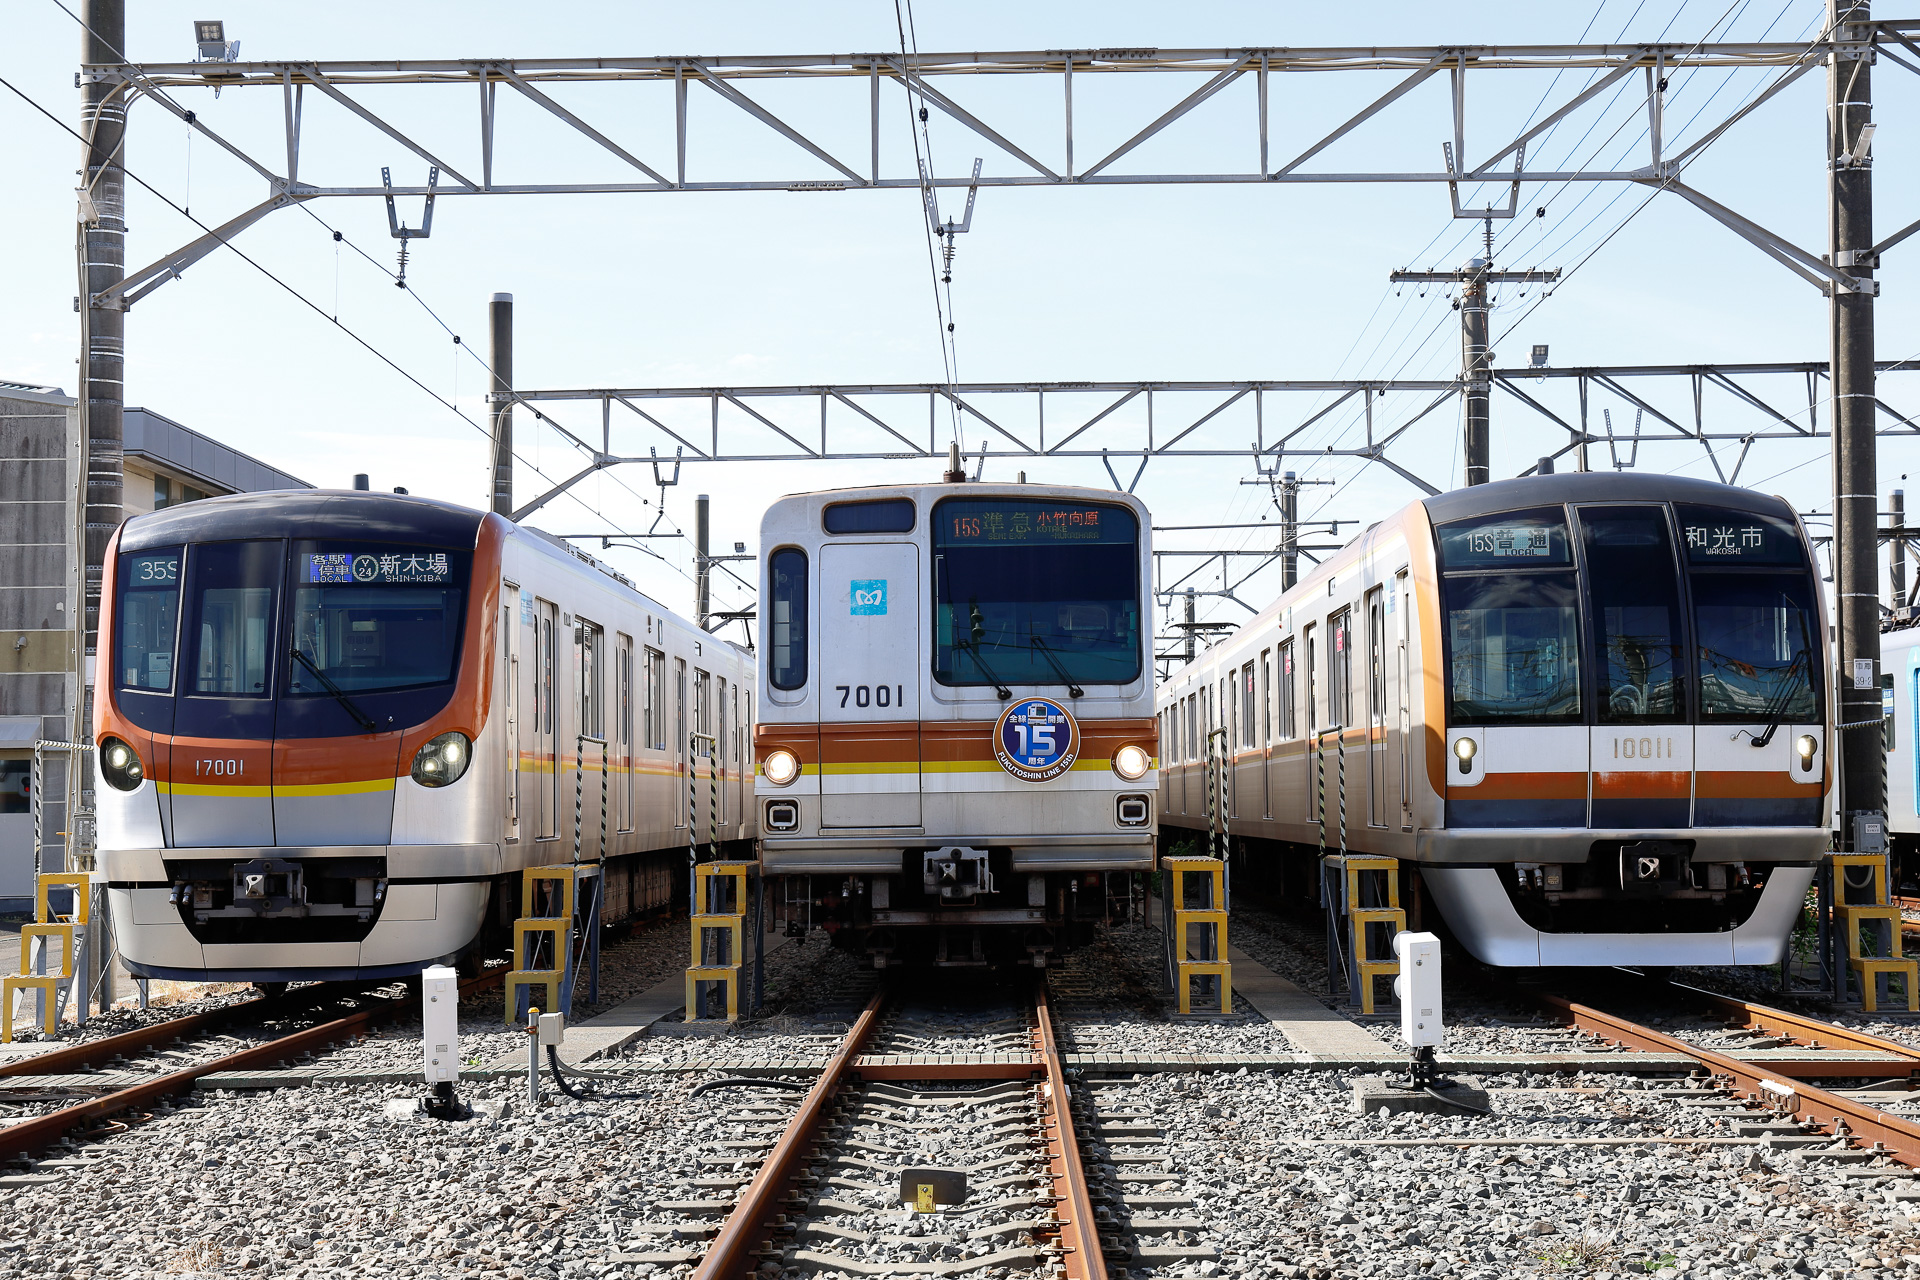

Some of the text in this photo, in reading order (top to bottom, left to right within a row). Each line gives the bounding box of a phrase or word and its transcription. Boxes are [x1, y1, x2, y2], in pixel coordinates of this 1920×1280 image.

[982, 512, 1031, 533] 準急
[1036, 511, 1099, 526] 小竹向原
[953, 518, 980, 537] 15S
[1466, 533, 1494, 553] 15S
[1496, 529, 1547, 549] 普通
[1685, 526, 1763, 548] 和光市
[1504, 548, 1538, 556] LOCAL
[1705, 547, 1742, 555] WAKOSHI
[312, 554, 346, 565] 各駅
[361, 559, 370, 567] Y
[379, 553, 448, 575] 新木場
[318, 565, 350, 576] 停車
[358, 567, 372, 577] 24
[385, 574, 442, 583] SHIN-KIBA
[313, 575, 348, 583] LOCAL
[835, 684, 903, 709] 7001
[1009, 714, 1027, 723] 全線
[1014, 725, 1056, 756] 15
[1613, 737, 1672, 759] 10011
[196, 759, 244, 776] 17001
[998, 751, 1074, 780] FUKUTOSHIN LINE 15th
[1028, 757, 1046, 765] 周年
